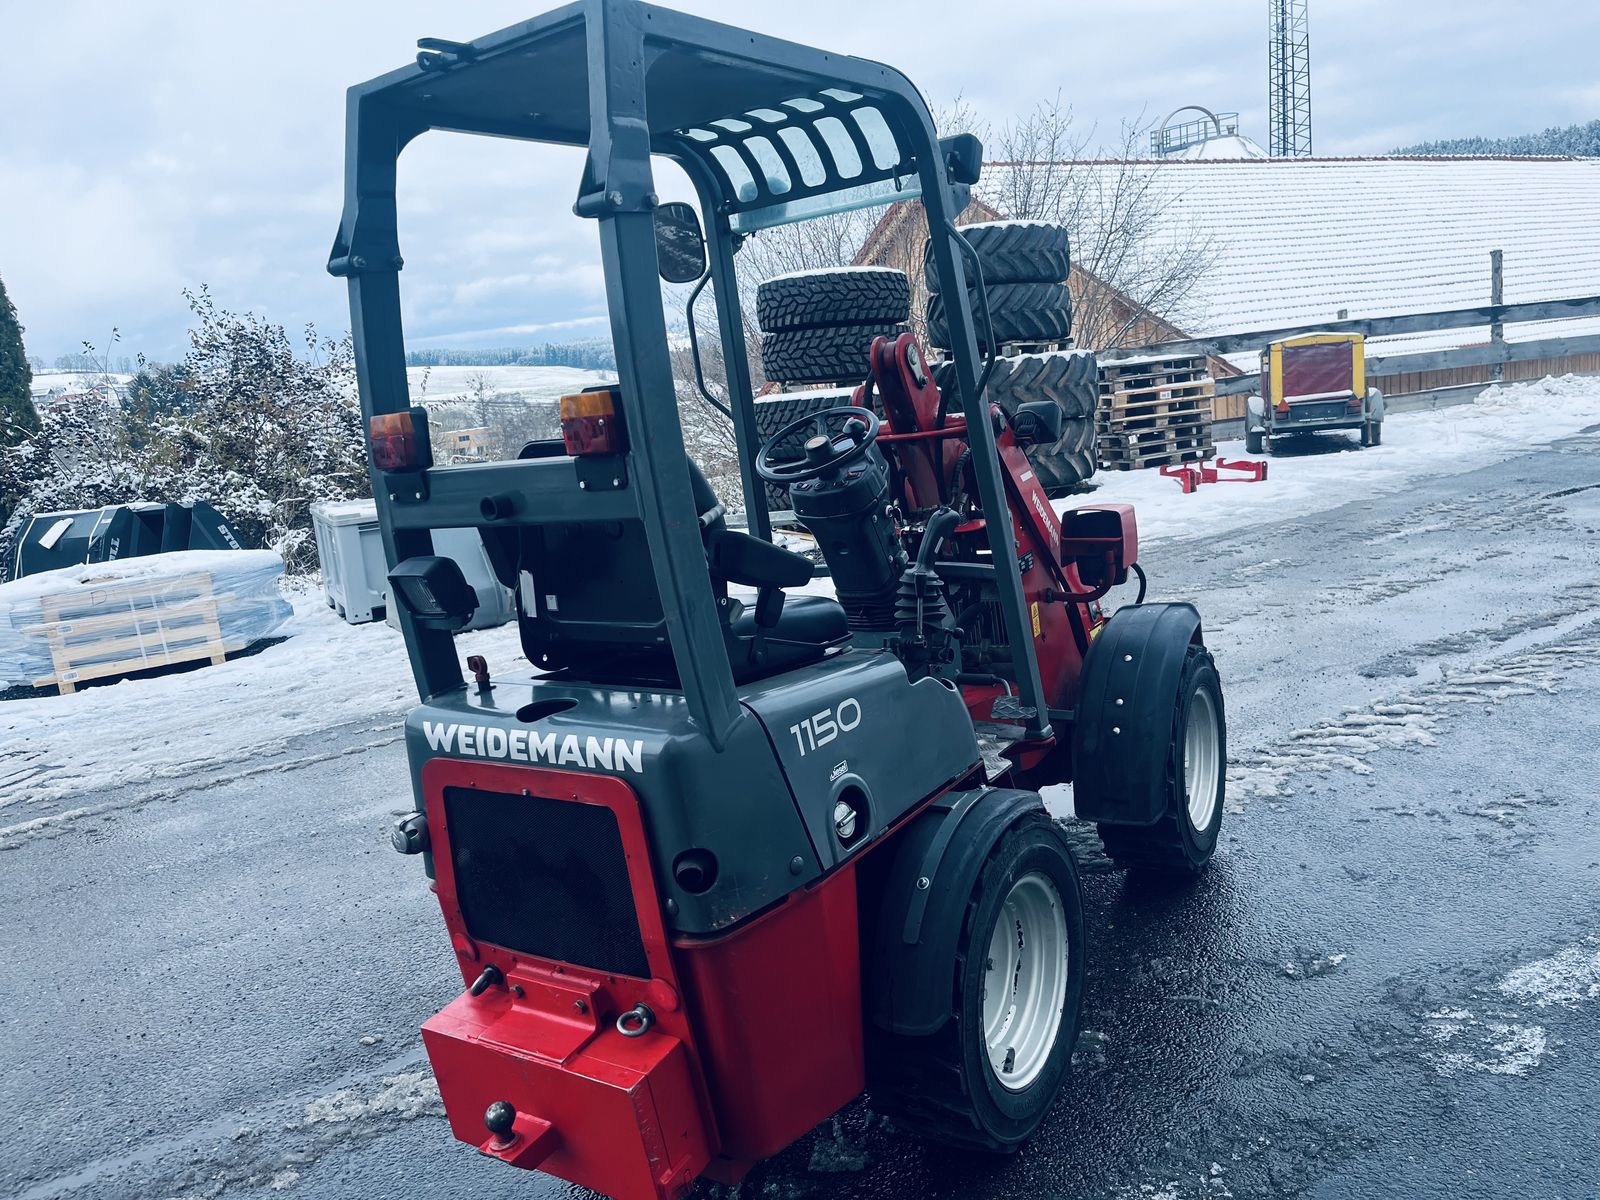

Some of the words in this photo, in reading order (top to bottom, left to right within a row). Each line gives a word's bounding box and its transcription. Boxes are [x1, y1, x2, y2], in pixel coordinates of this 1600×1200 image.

[217, 524, 242, 550] STO
[422, 721, 644, 773] WEIDEMANN
[789, 698, 861, 757] 1150
